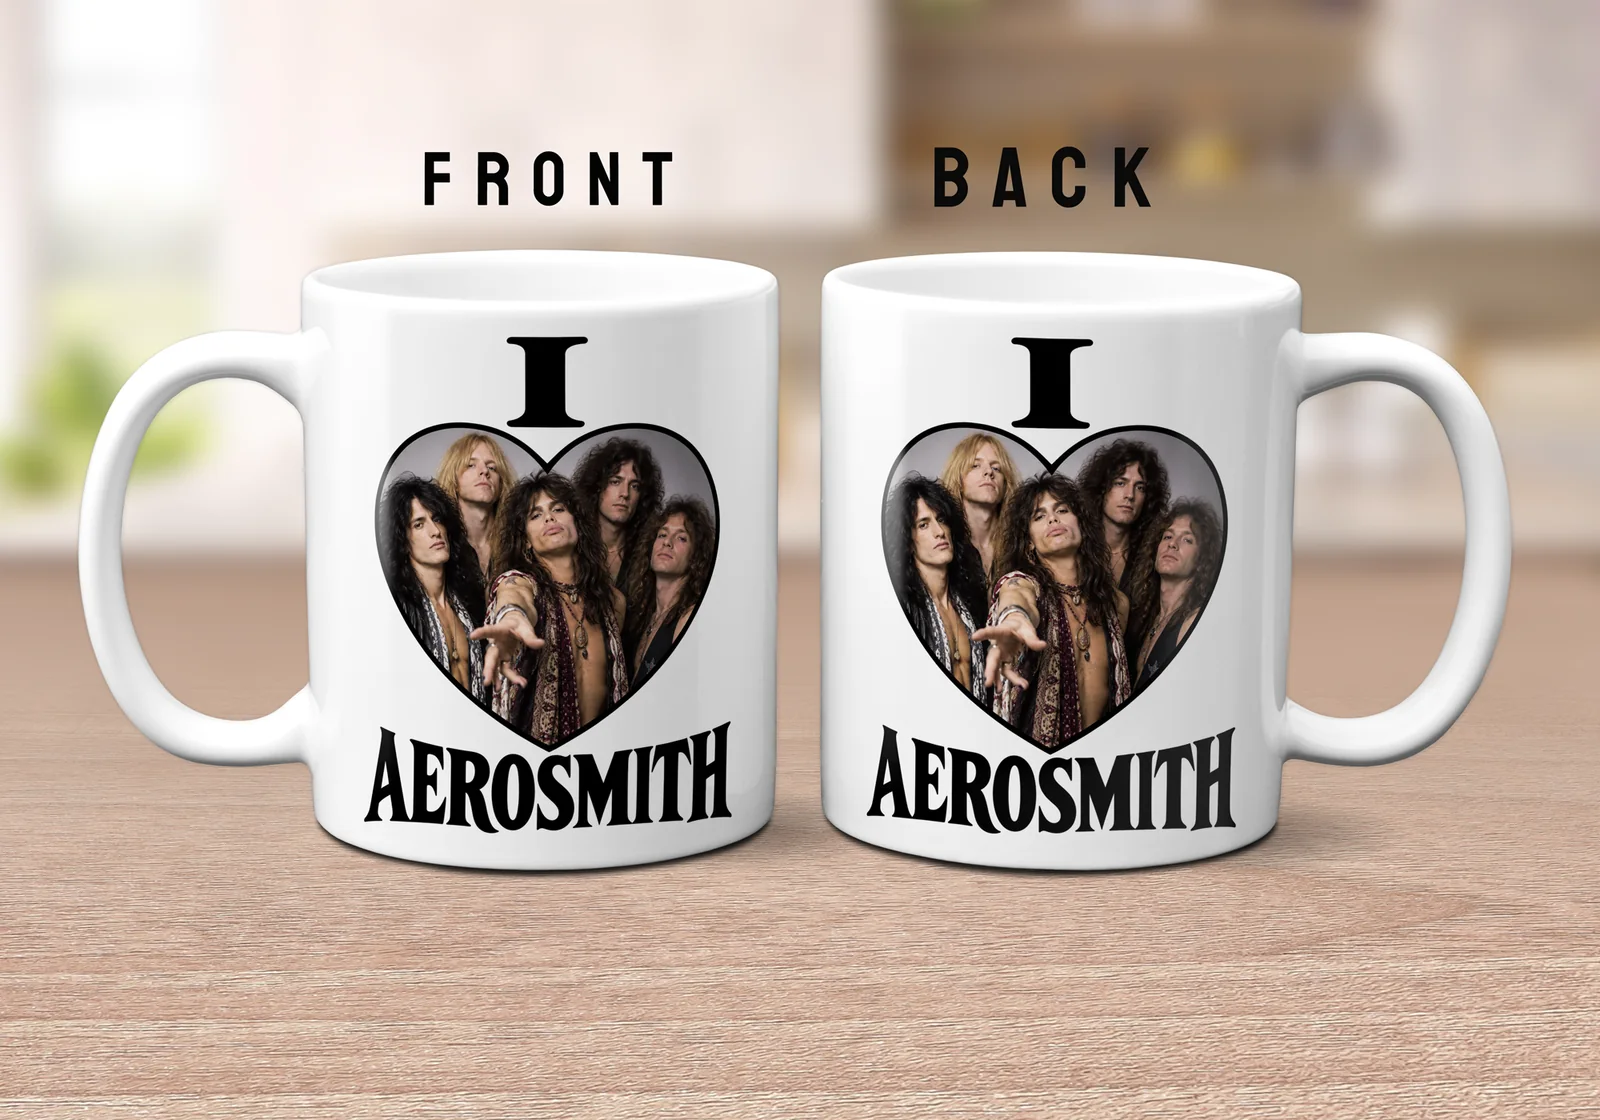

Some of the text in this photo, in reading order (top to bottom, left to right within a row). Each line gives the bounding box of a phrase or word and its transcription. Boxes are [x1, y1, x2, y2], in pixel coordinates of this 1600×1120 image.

[507, 337, 588, 428] I
[1011, 338, 1093, 429] I
[364, 721, 732, 833] AEROSMITH
[867, 725, 1236, 833] AEROSMITH
